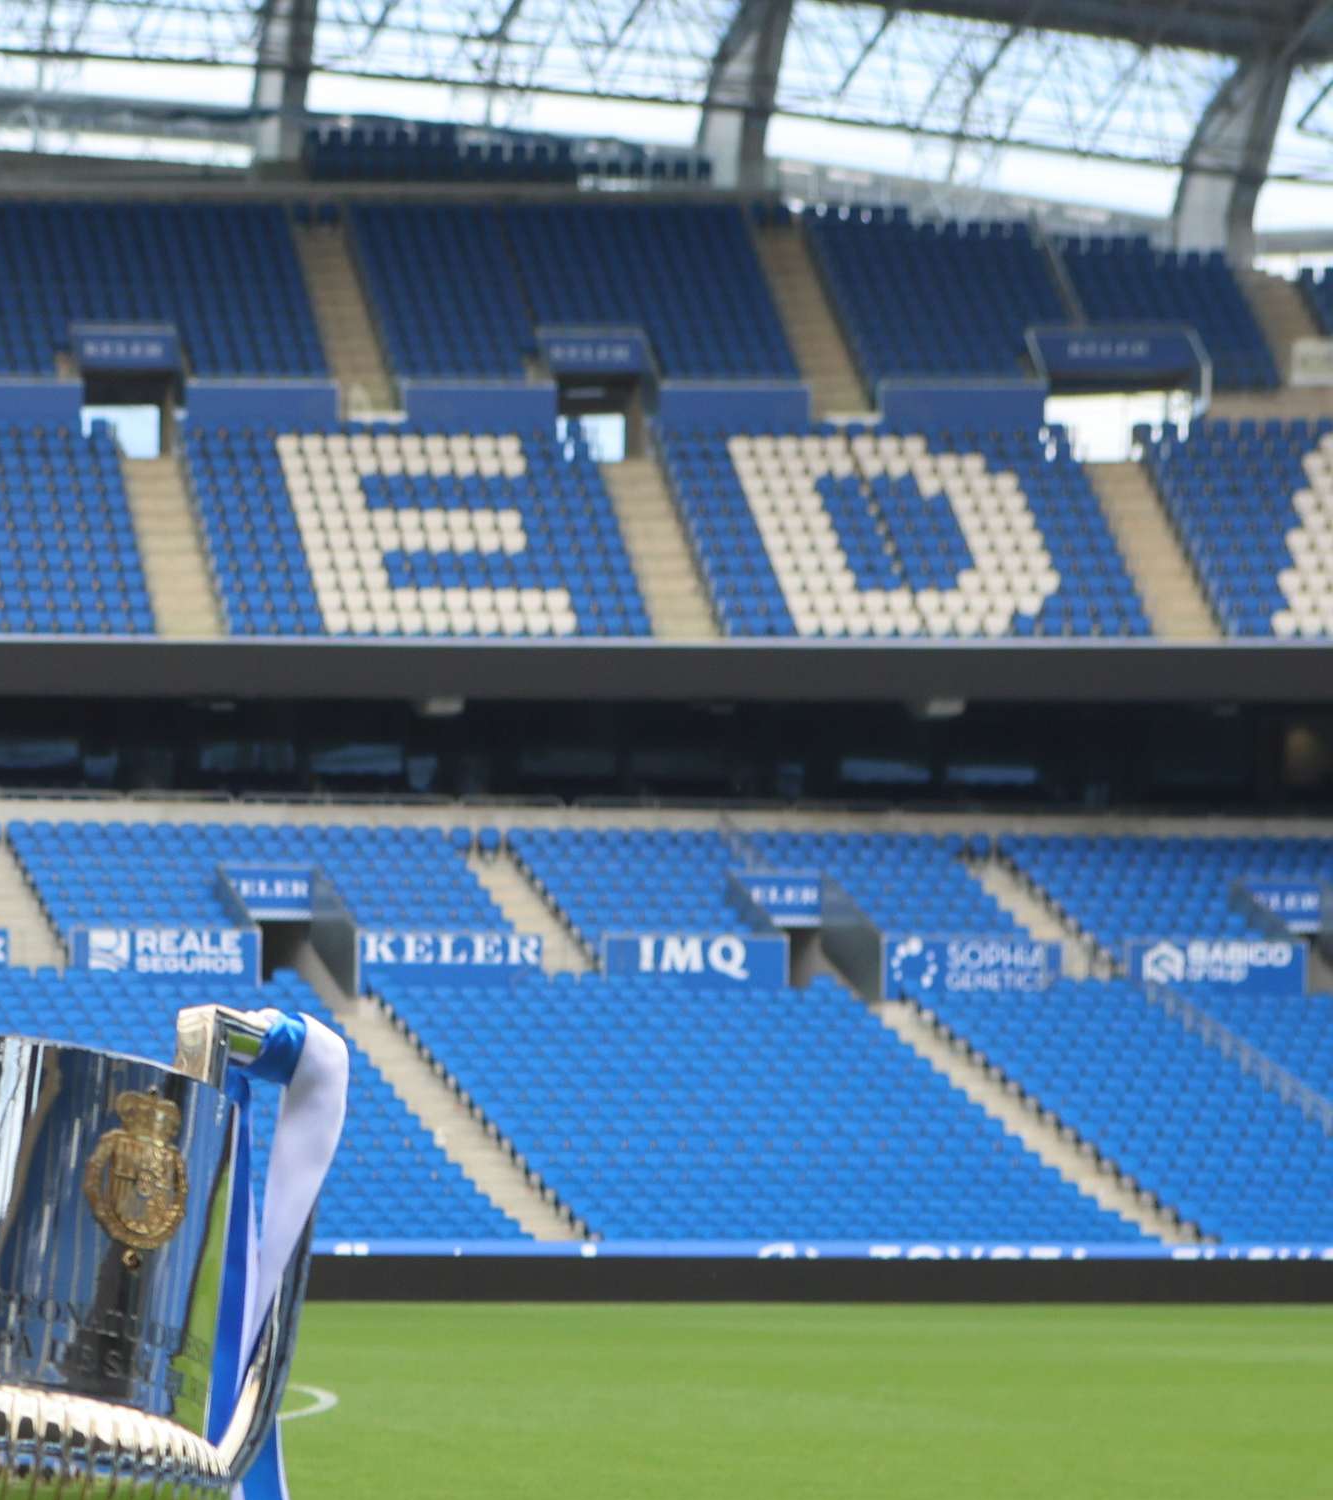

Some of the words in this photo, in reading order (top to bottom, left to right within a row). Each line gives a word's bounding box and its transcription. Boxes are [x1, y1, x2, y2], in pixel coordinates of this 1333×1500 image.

[232, 879, 310, 898] ELER
[135, 928, 242, 955] REALE
[364, 933, 541, 965] KELER
[135, 955, 245, 975] SEGUROS
[638, 935, 749, 980] IMQ
